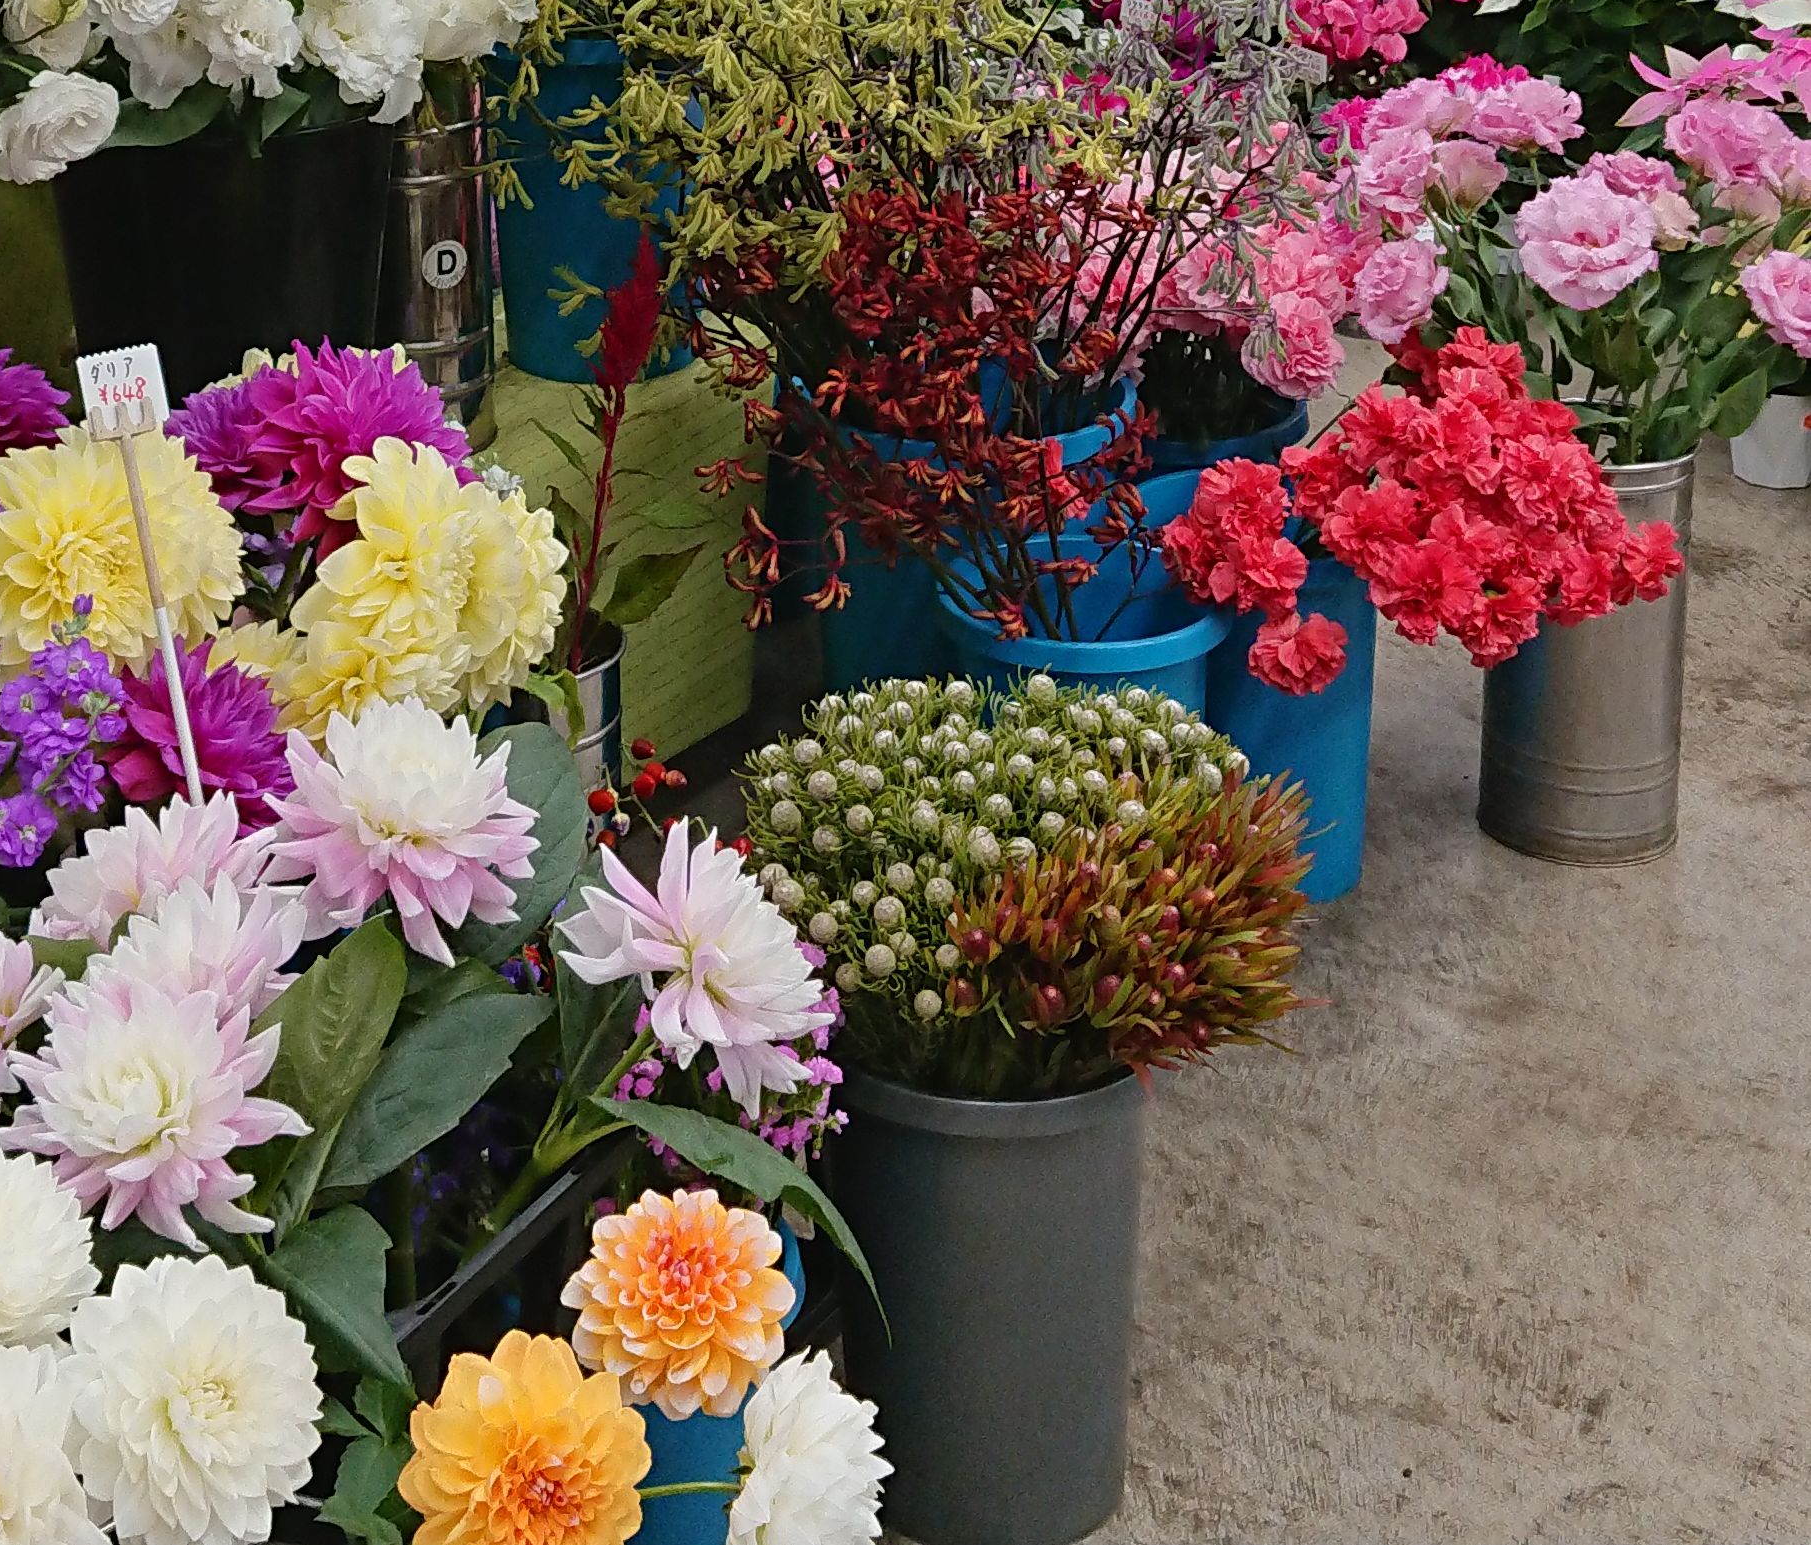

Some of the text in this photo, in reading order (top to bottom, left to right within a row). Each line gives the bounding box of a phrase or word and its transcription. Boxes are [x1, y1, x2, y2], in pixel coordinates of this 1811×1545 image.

[437, 250, 457, 276] D
[91, 356, 133, 385] ダリア
[98, 376, 147, 405] ¥648
